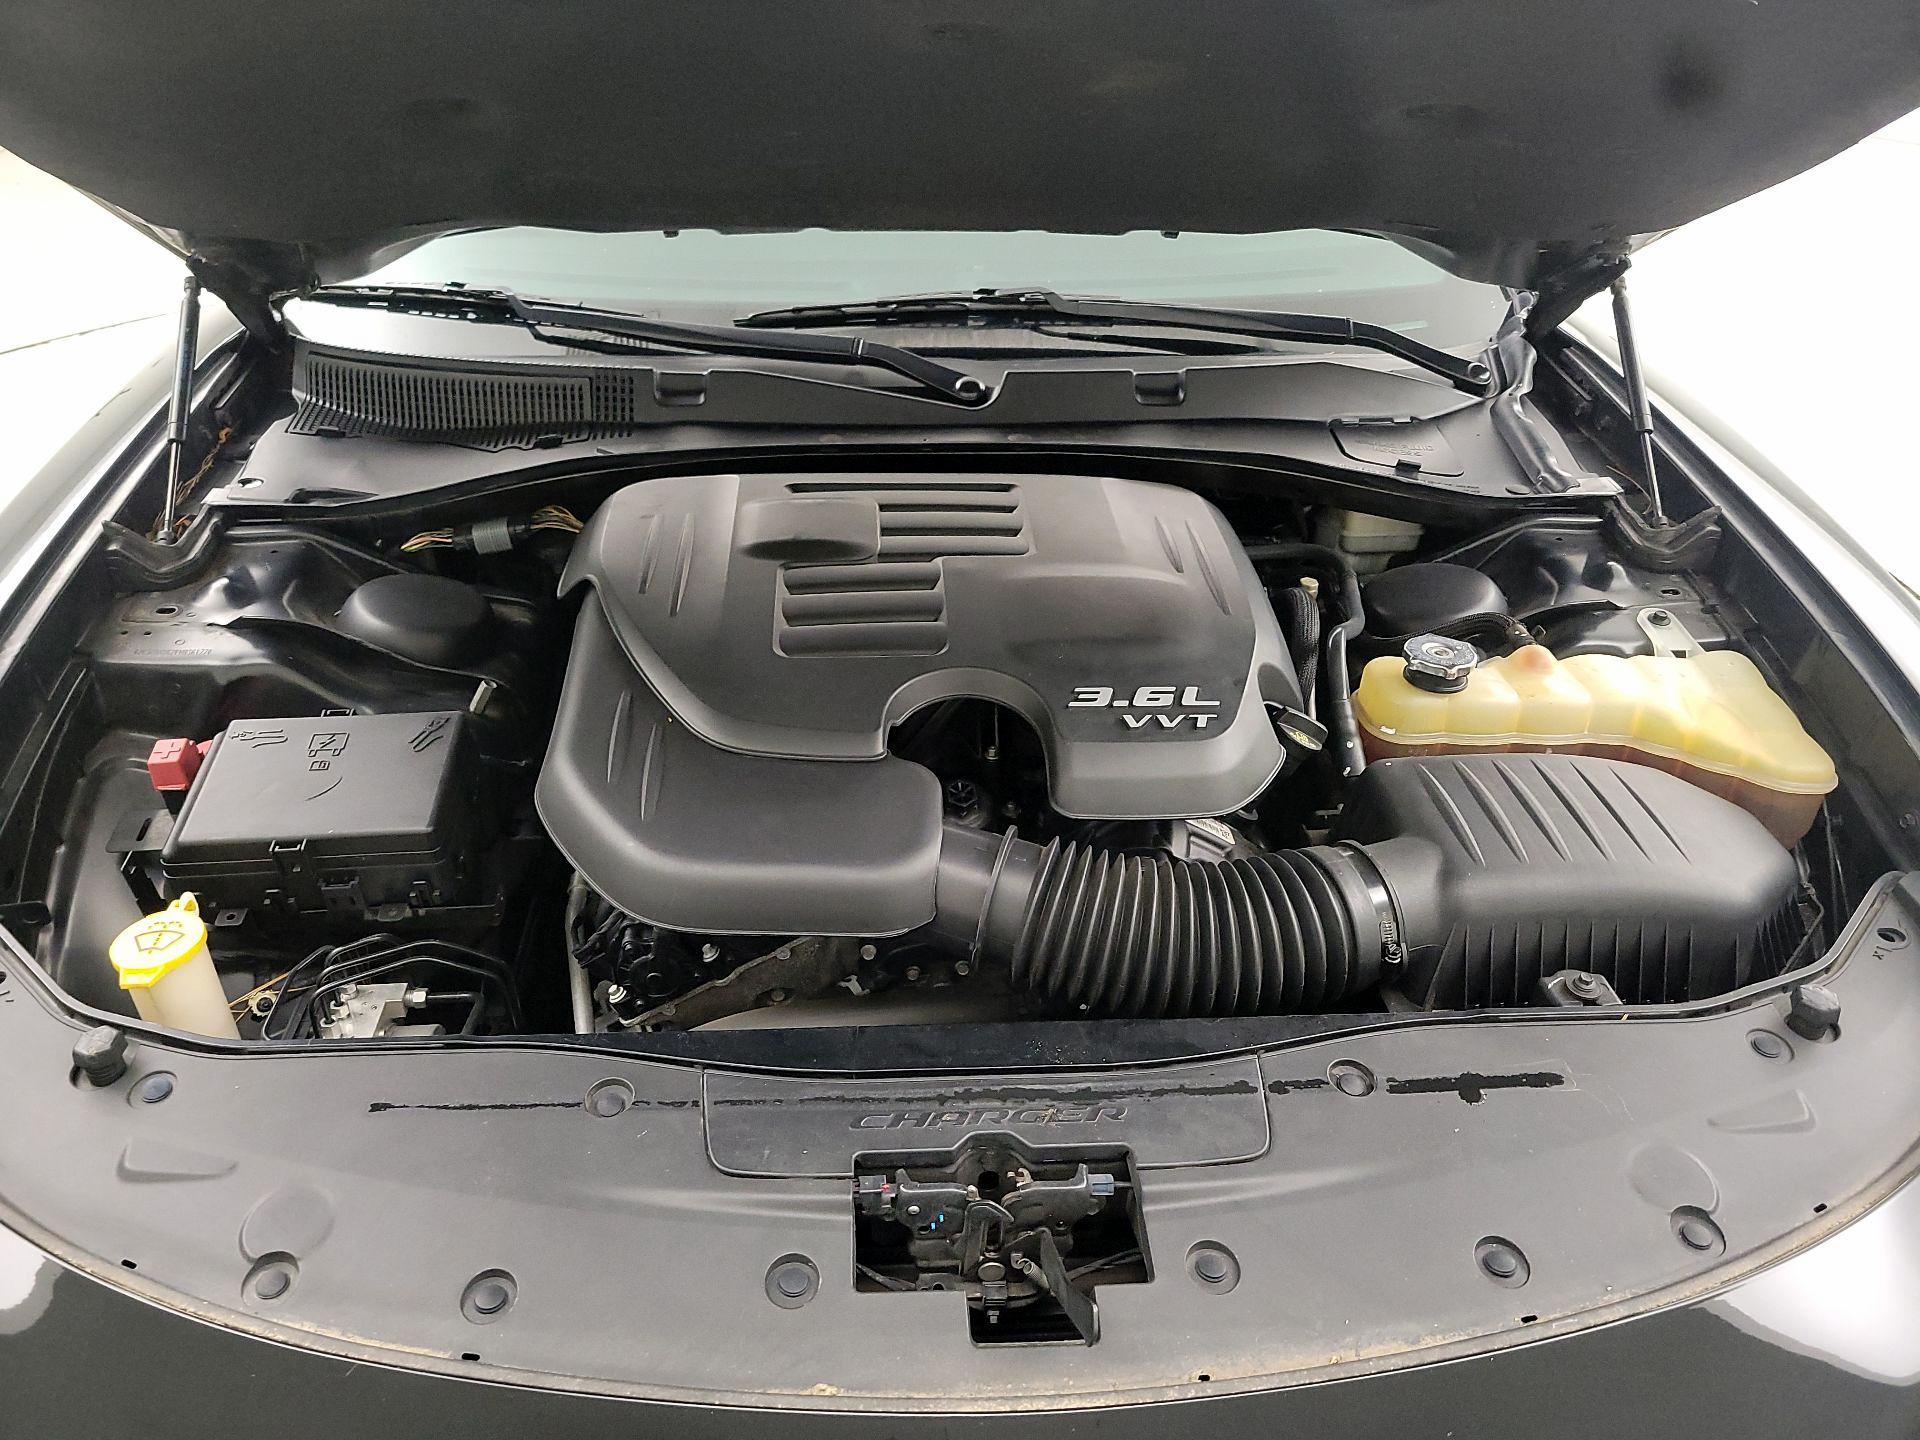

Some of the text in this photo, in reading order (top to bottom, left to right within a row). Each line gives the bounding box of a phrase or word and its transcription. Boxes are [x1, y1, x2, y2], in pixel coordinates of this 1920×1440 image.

[1067, 686, 1221, 708] 3.6L
[1120, 714, 1218, 729] VVT
[849, 1106, 1128, 1130] CHARGER
